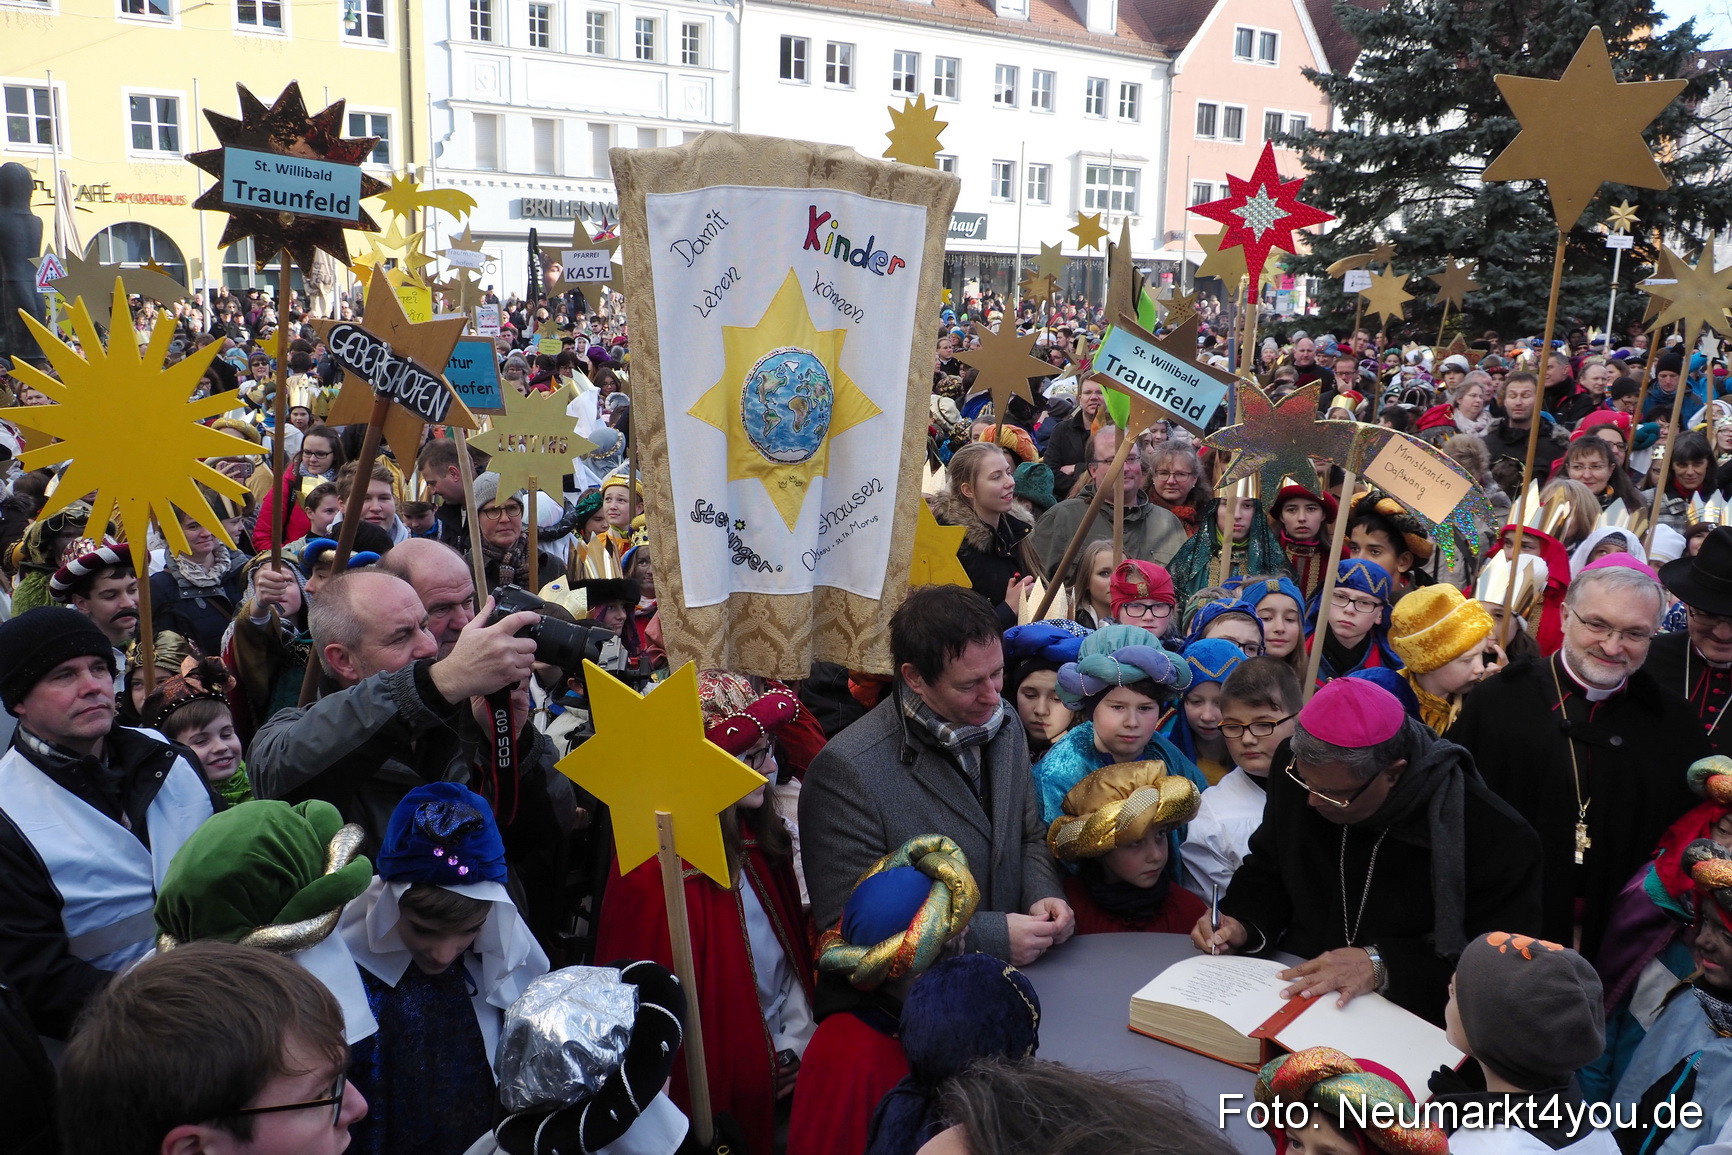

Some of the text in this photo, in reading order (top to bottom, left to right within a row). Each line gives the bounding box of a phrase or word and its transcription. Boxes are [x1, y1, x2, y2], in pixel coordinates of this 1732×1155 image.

[255, 160, 332, 181] St. Willibald
[232, 179, 350, 214] Traunfeld
[521, 197, 595, 218] BRILLEN
[670, 205, 906, 276] Damit Kinder
[566, 266, 610, 280] KASTL
[693, 266, 865, 324] Leben können
[1132, 345, 1200, 387] St. Willibald
[1106, 354, 1206, 421] Traunfeld
[498, 433, 568, 454] LENTING
[1384, 462, 1426, 501] Daßwang
[1394, 444, 1452, 489] Ministranten
[849, 515, 879, 534] Morus
[495, 709, 510, 769] EOS 60D
